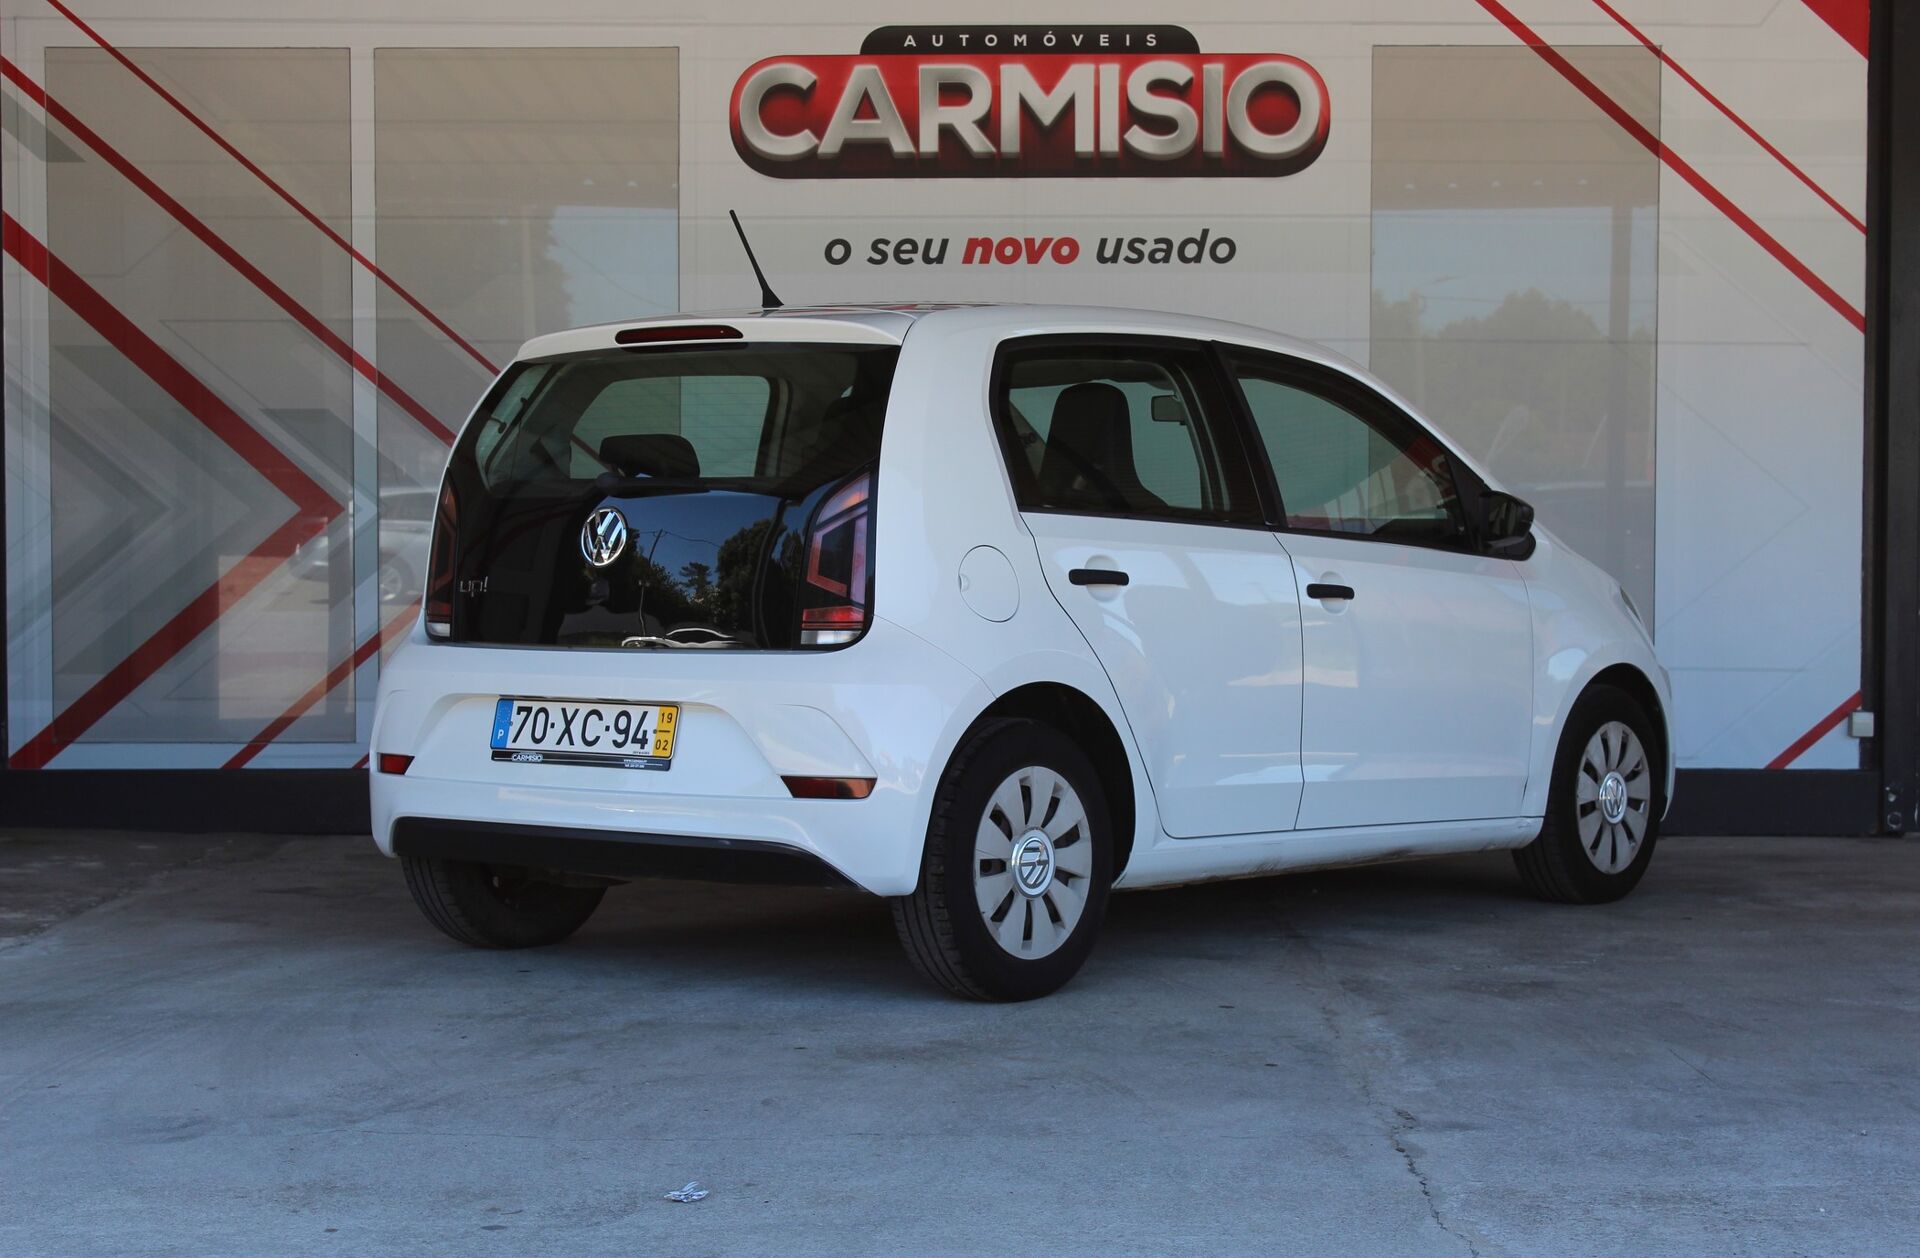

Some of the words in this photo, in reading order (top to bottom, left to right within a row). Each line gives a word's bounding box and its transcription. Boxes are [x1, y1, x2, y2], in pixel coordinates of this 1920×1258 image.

[903, 31, 1158, 47] AUTOMÓVEIS
[738, 61, 1322, 161] CARMISIO
[824, 237, 852, 266] o
[866, 237, 950, 266] seu
[961, 236, 1080, 265] novo
[1096, 228, 1237, 265] usado
[661, 712, 673, 724] 19
[497, 728, 505, 740] P
[655, 739, 669, 751] 02
